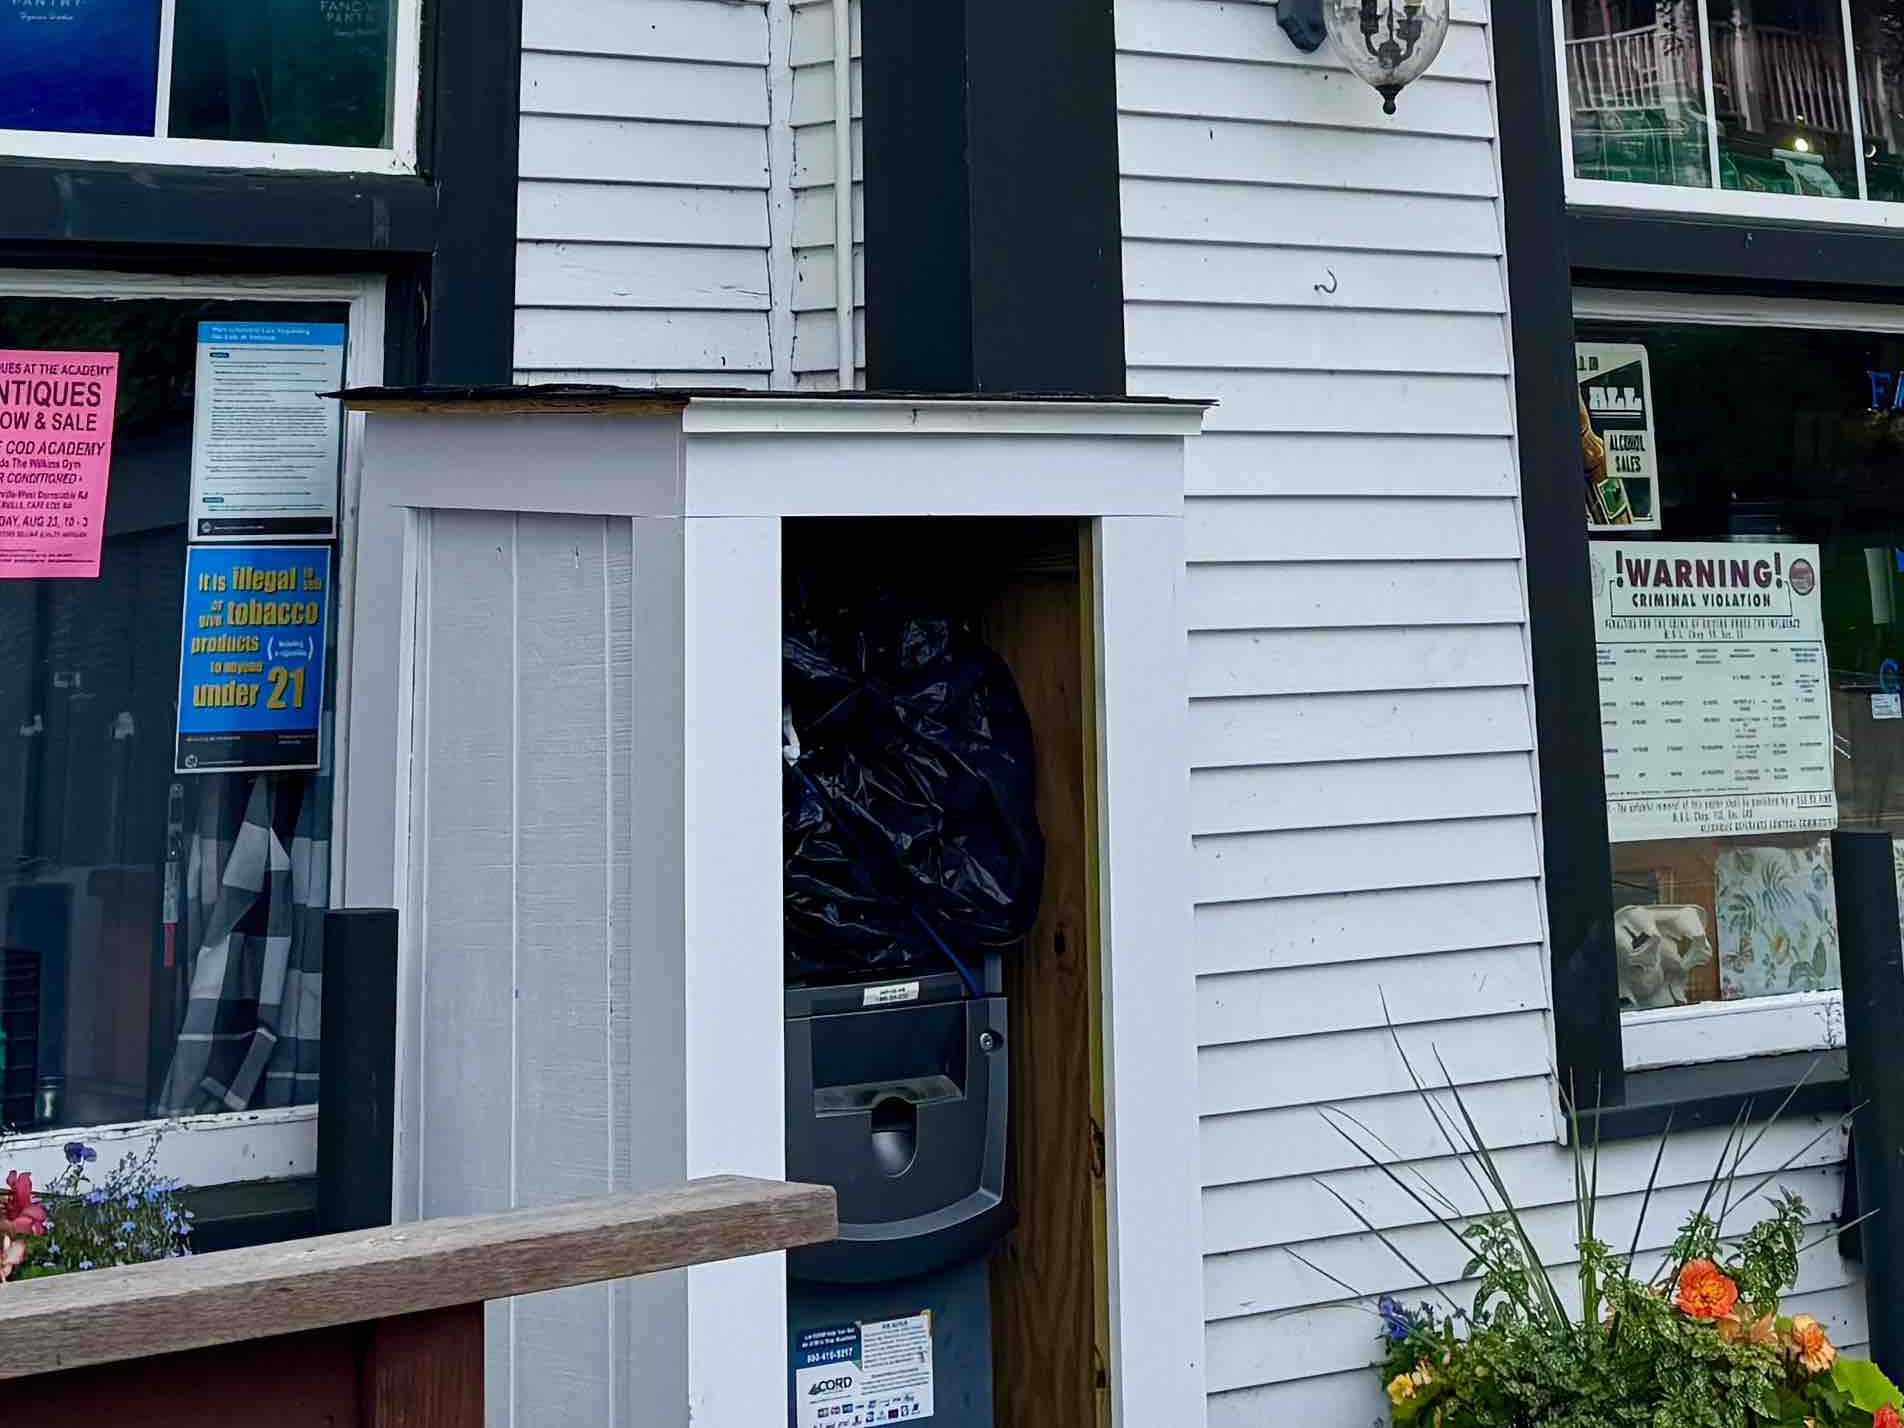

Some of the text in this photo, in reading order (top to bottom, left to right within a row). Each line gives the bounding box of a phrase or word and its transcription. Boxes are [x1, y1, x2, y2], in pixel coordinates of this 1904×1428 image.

[24, 364, 36, 375] AT
[40, 364, 57, 376] THE
[1588, 386, 1643, 411] ALL
[34, 411, 47, 430] &
[52, 413, 98, 431] SALE
[6, 440, 36, 456] COD
[38, 441, 106, 457] ACADEMY
[1616, 455, 1642, 473] SALES
[7, 472, 77, 484] CONDITIONED
[23, 516, 45, 528] AUG
[1632, 592, 1771, 608] CRIMINAL VIOLATION
[227, 598, 320, 627] tobacco
[191, 632, 260, 655] products
[192, 665, 306, 712] under 21
